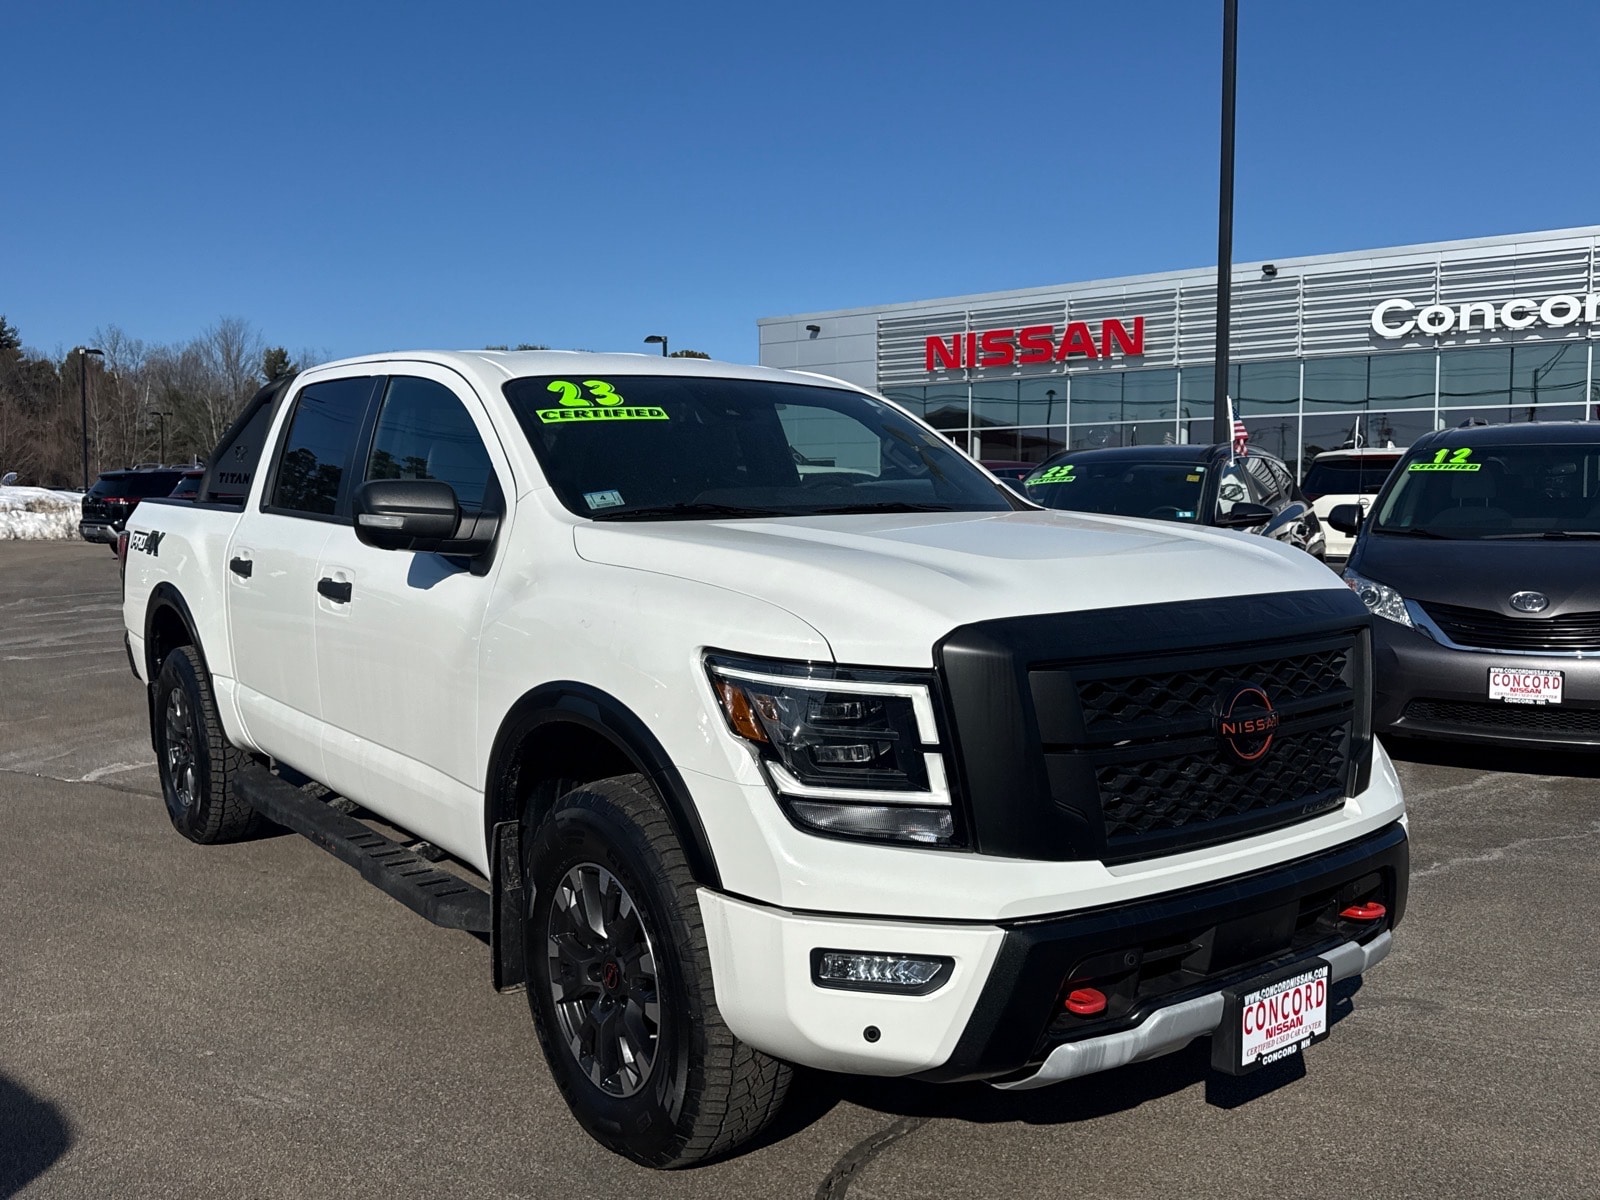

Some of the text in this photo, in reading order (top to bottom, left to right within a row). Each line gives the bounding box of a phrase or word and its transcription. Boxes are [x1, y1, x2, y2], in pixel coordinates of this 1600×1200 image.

[926, 316, 1144, 371] NISSAN
[547, 380, 624, 407] 23
[540, 408, 665, 420] CERTIFIED
[1409, 463, 1480, 471] CERTIFIED
[1433, 447, 1473, 464] 12
[219, 472, 251, 484] TITAN
[1041, 465, 1074, 478] 23
[1492, 674, 1560, 689] CONCORD
[1222, 712, 1279, 735] NISSAN
[1244, 966, 1328, 1006] WWW.CONCORDNISSAN.COM
[1244, 980, 1325, 1035] CONCORD
[1246, 1020, 1322, 1057] CERTIFIED USED CAR CENTER
[1265, 1015, 1303, 1040] NISSAN
[1262, 1038, 1311, 1065] CONCORD NH
